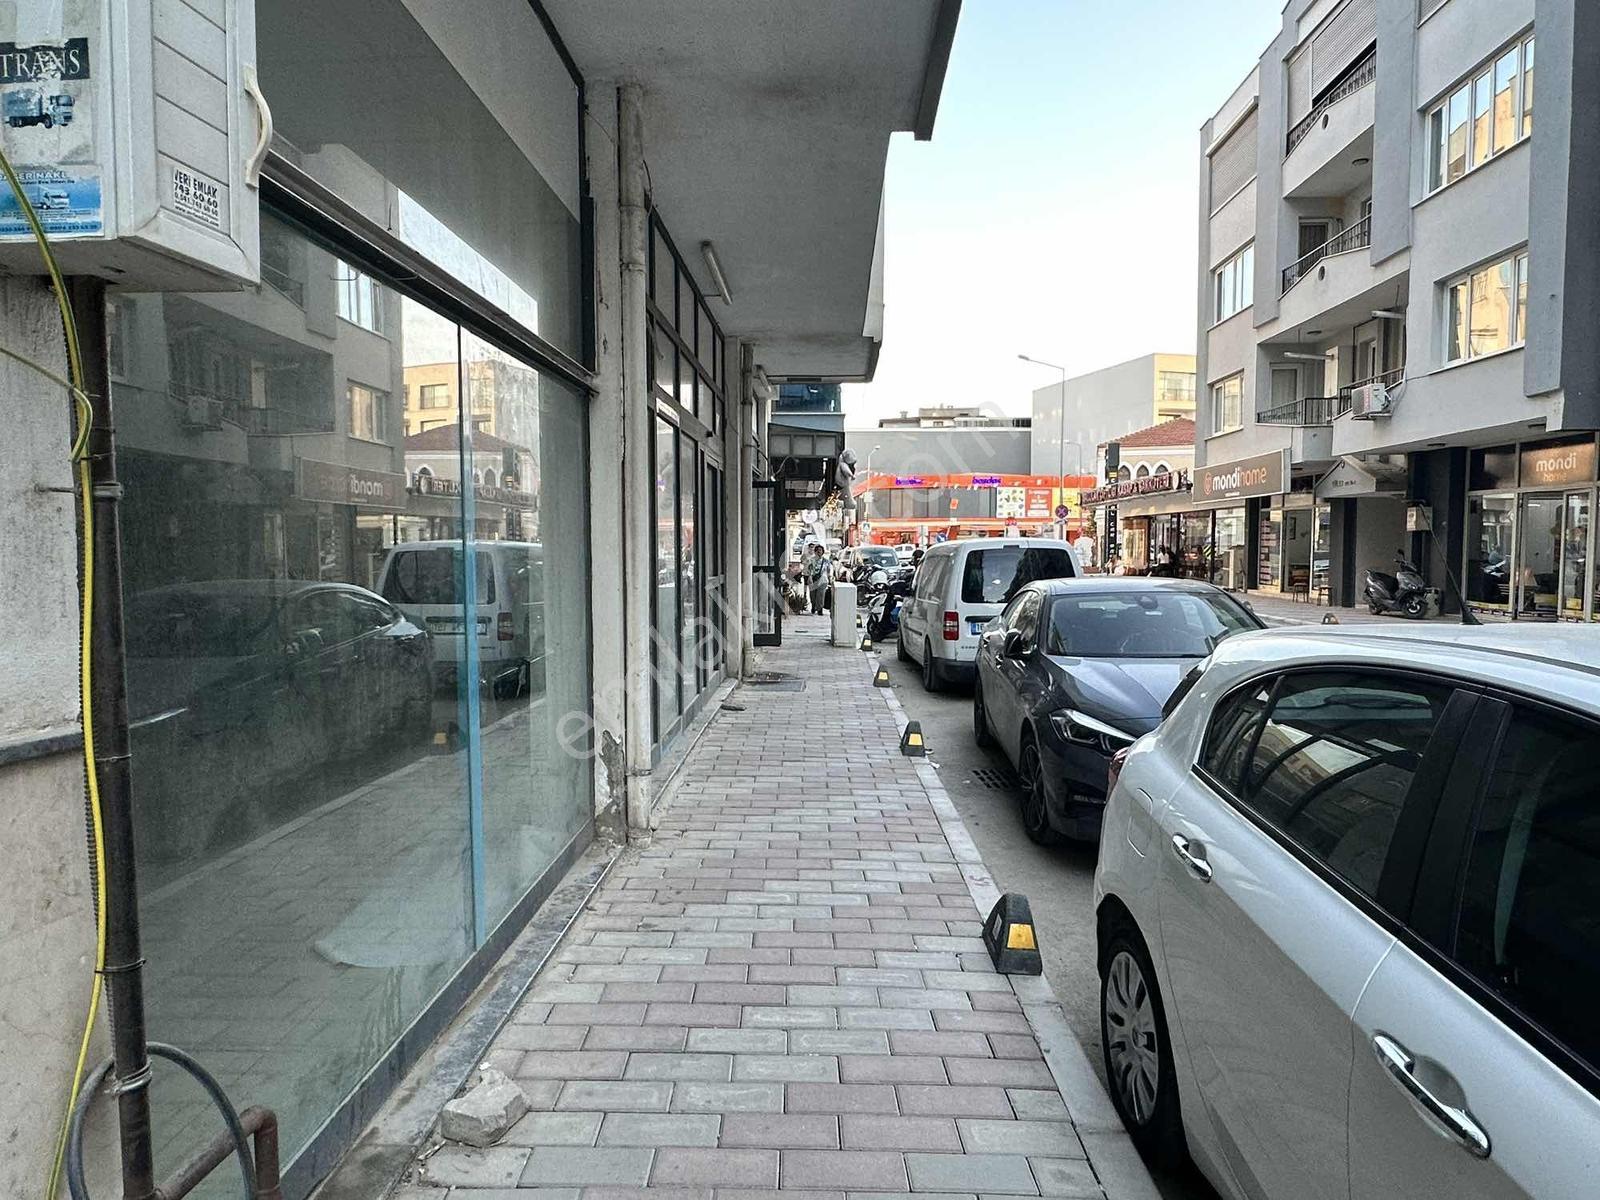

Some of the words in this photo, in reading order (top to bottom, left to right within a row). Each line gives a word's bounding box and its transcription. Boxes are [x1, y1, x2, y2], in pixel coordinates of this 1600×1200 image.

[0, 49, 80, 78] TRANS
[174, 182, 190, 196] 743
[193, 191, 205, 202] 60
[207, 197, 218, 208] 60
[193, 178, 217, 199] EMLAK
[1535, 452, 1577, 472] mondi
